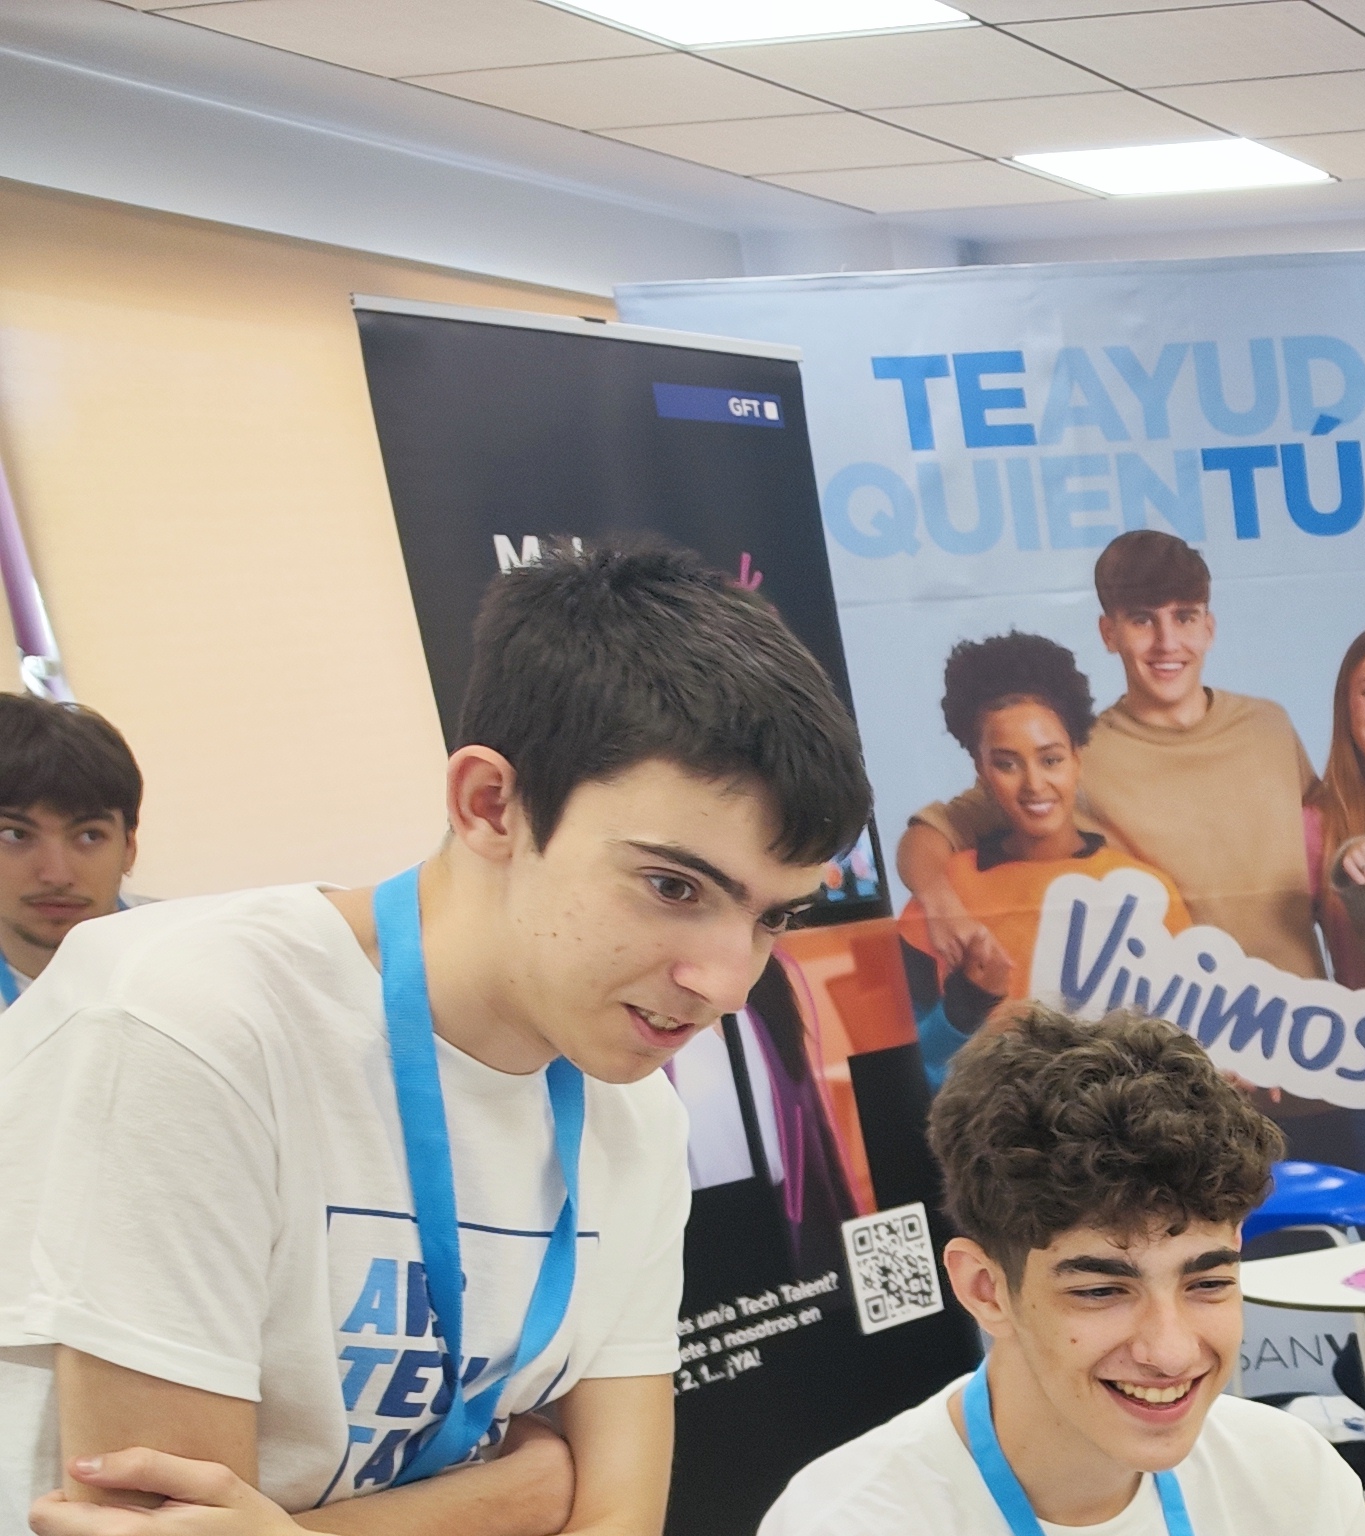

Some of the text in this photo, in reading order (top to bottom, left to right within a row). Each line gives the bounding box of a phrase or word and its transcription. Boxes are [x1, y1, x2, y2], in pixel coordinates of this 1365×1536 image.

[728, 397, 760, 418] GFT
[735, 1289, 780, 1317] Tech
[778, 1270, 840, 1304] Talent?
[723, 1312, 799, 1348] nosotros
[798, 1305, 823, 1327] en
